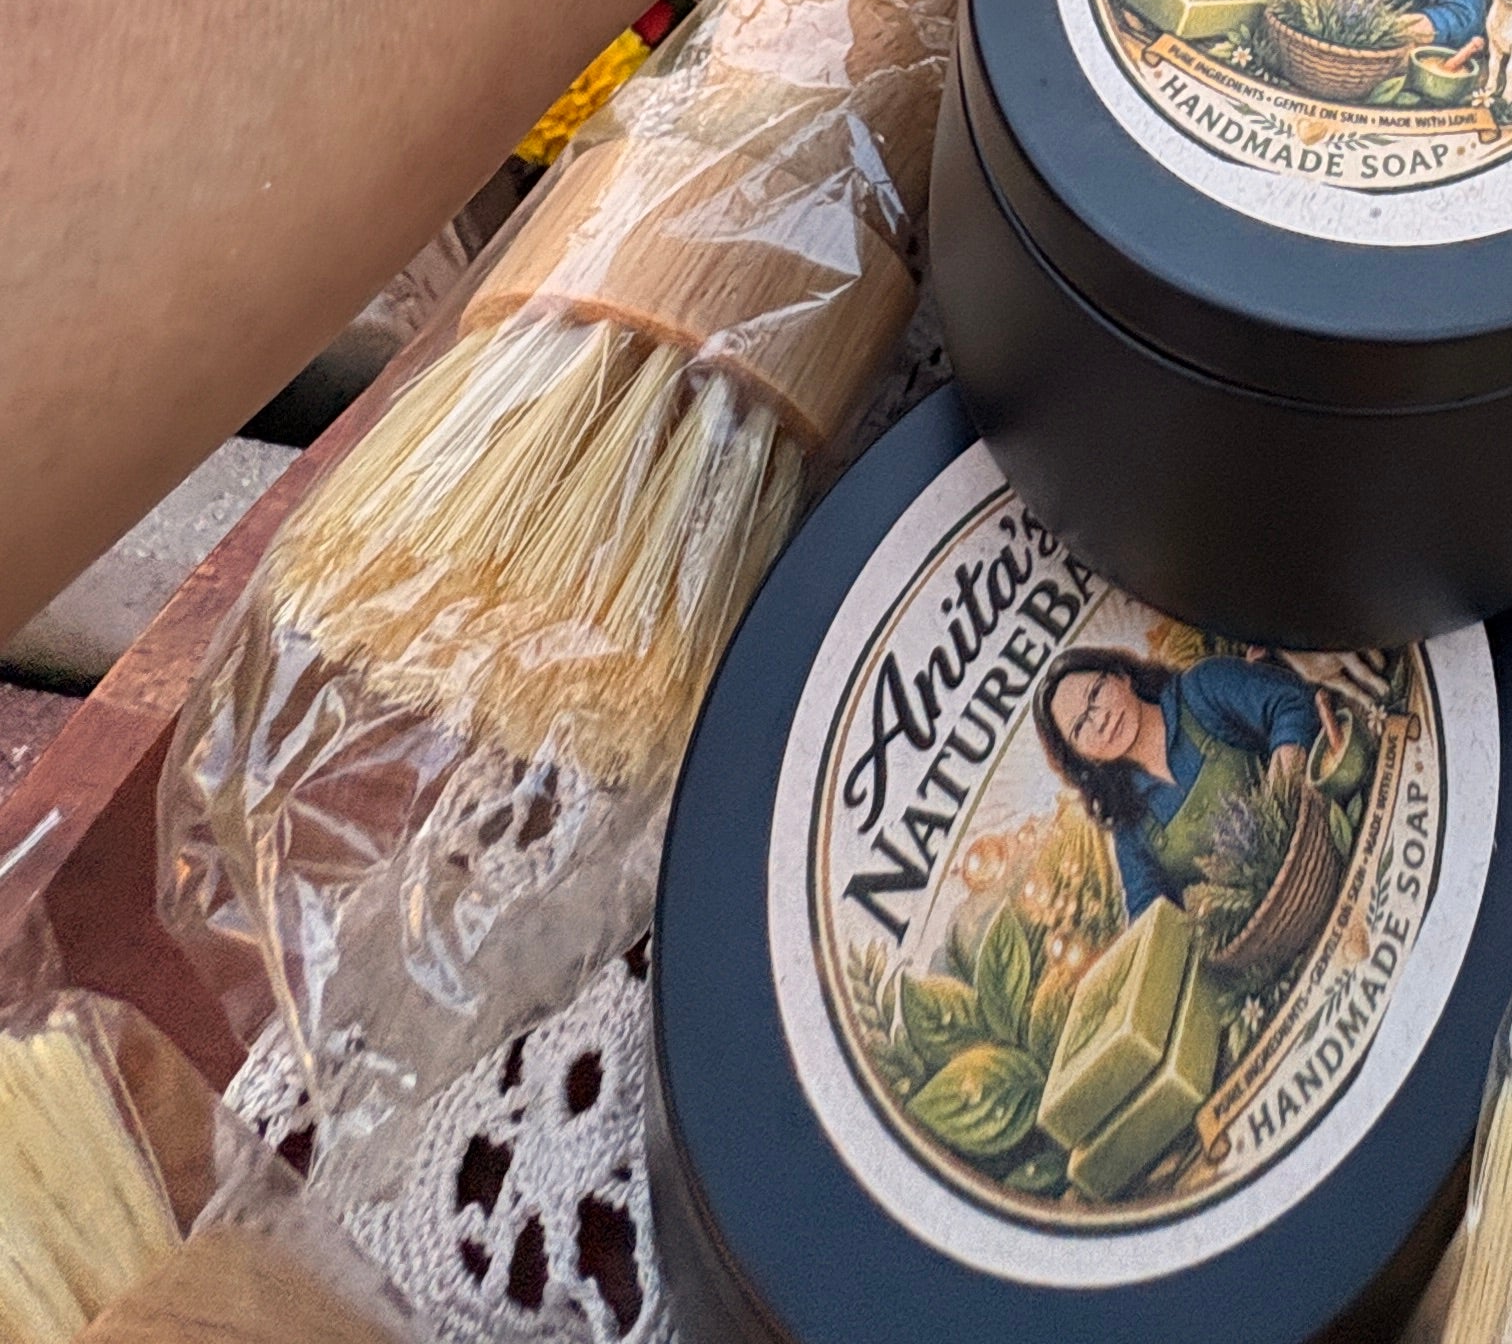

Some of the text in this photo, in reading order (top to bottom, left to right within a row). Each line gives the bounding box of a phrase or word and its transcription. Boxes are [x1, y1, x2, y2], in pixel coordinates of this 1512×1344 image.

[1160, 74, 1449, 179] HANDMADE SOAP
[1194, 61, 1265, 101] INGREDIENTS
[1274, 96, 1317, 118] GENTLE
[1321, 108, 1338, 121] ON
[1340, 111, 1368, 125] SKIN
[1378, 115, 1411, 128] MADE
[843, 552, 1096, 948] NATUREBA
[1249, 781, 1429, 1148] HANDMADE SOAP
